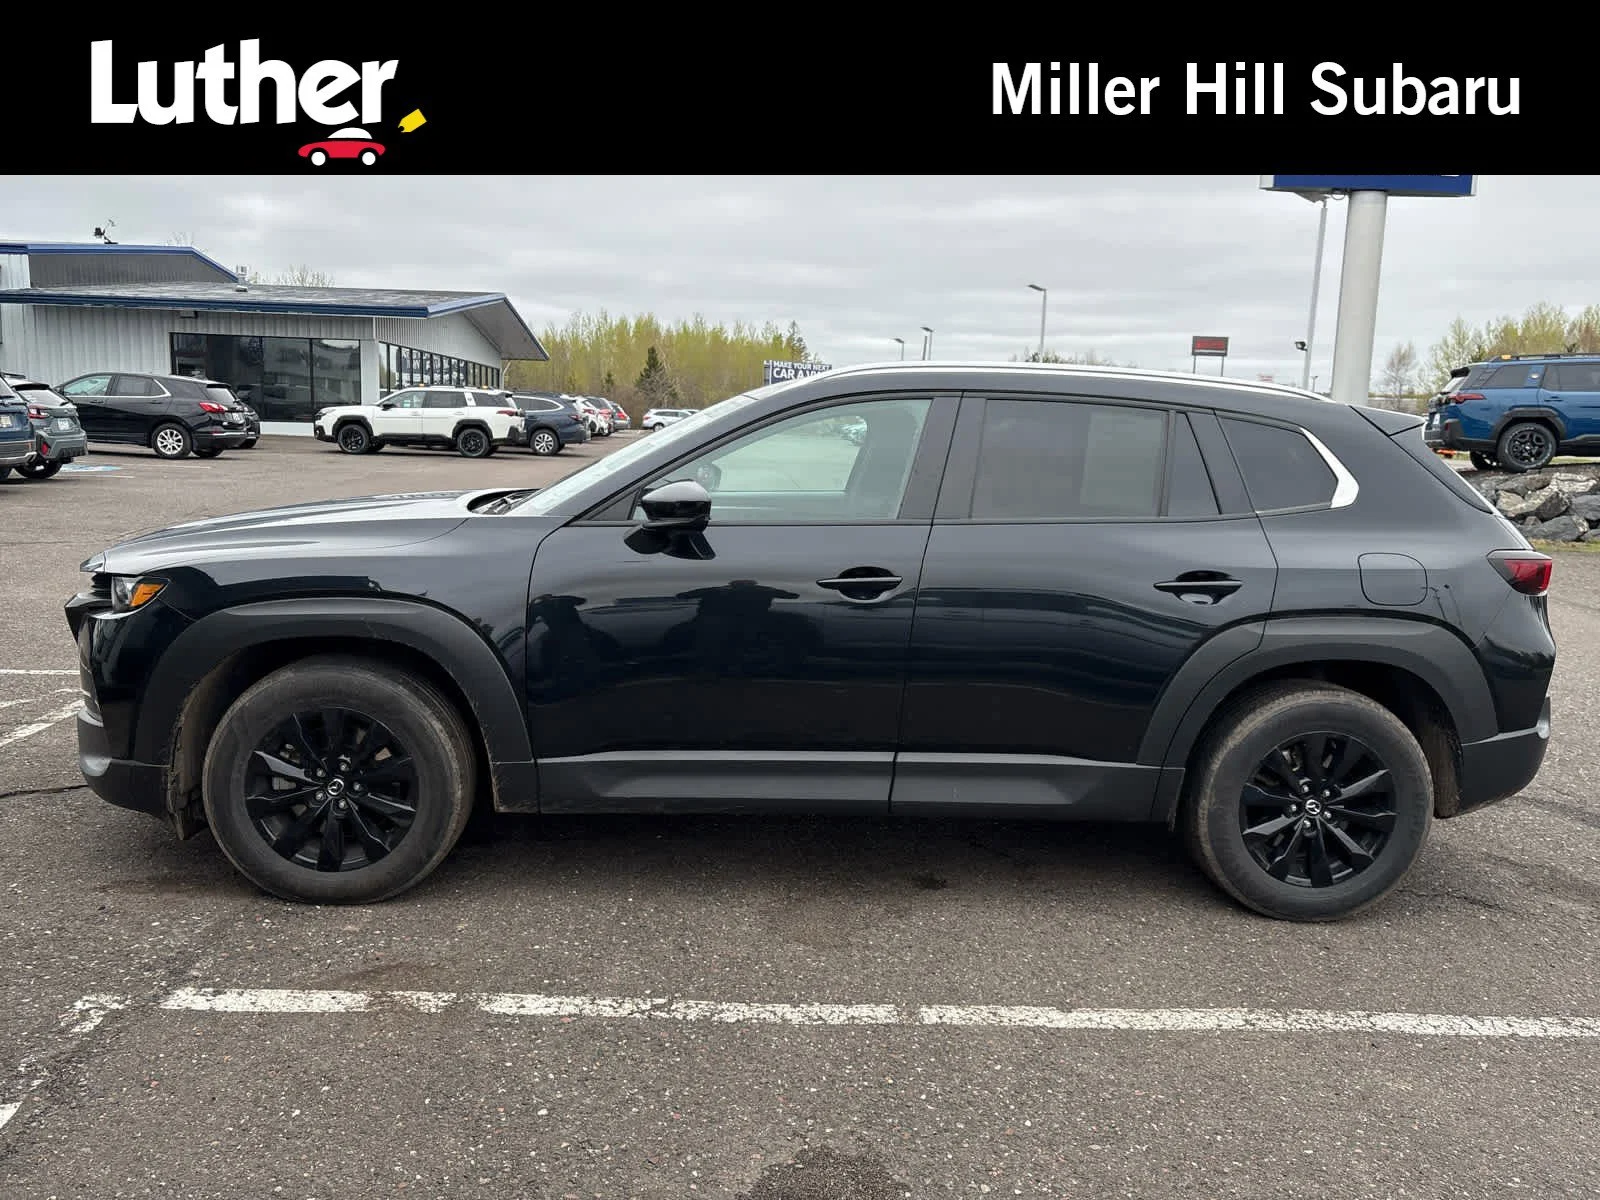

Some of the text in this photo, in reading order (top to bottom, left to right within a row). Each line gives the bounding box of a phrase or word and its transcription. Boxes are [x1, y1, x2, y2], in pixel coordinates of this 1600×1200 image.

[773, 360, 792, 368] MAKE
[793, 362, 811, 370] YOUR
[773, 368, 795, 380] CAR
